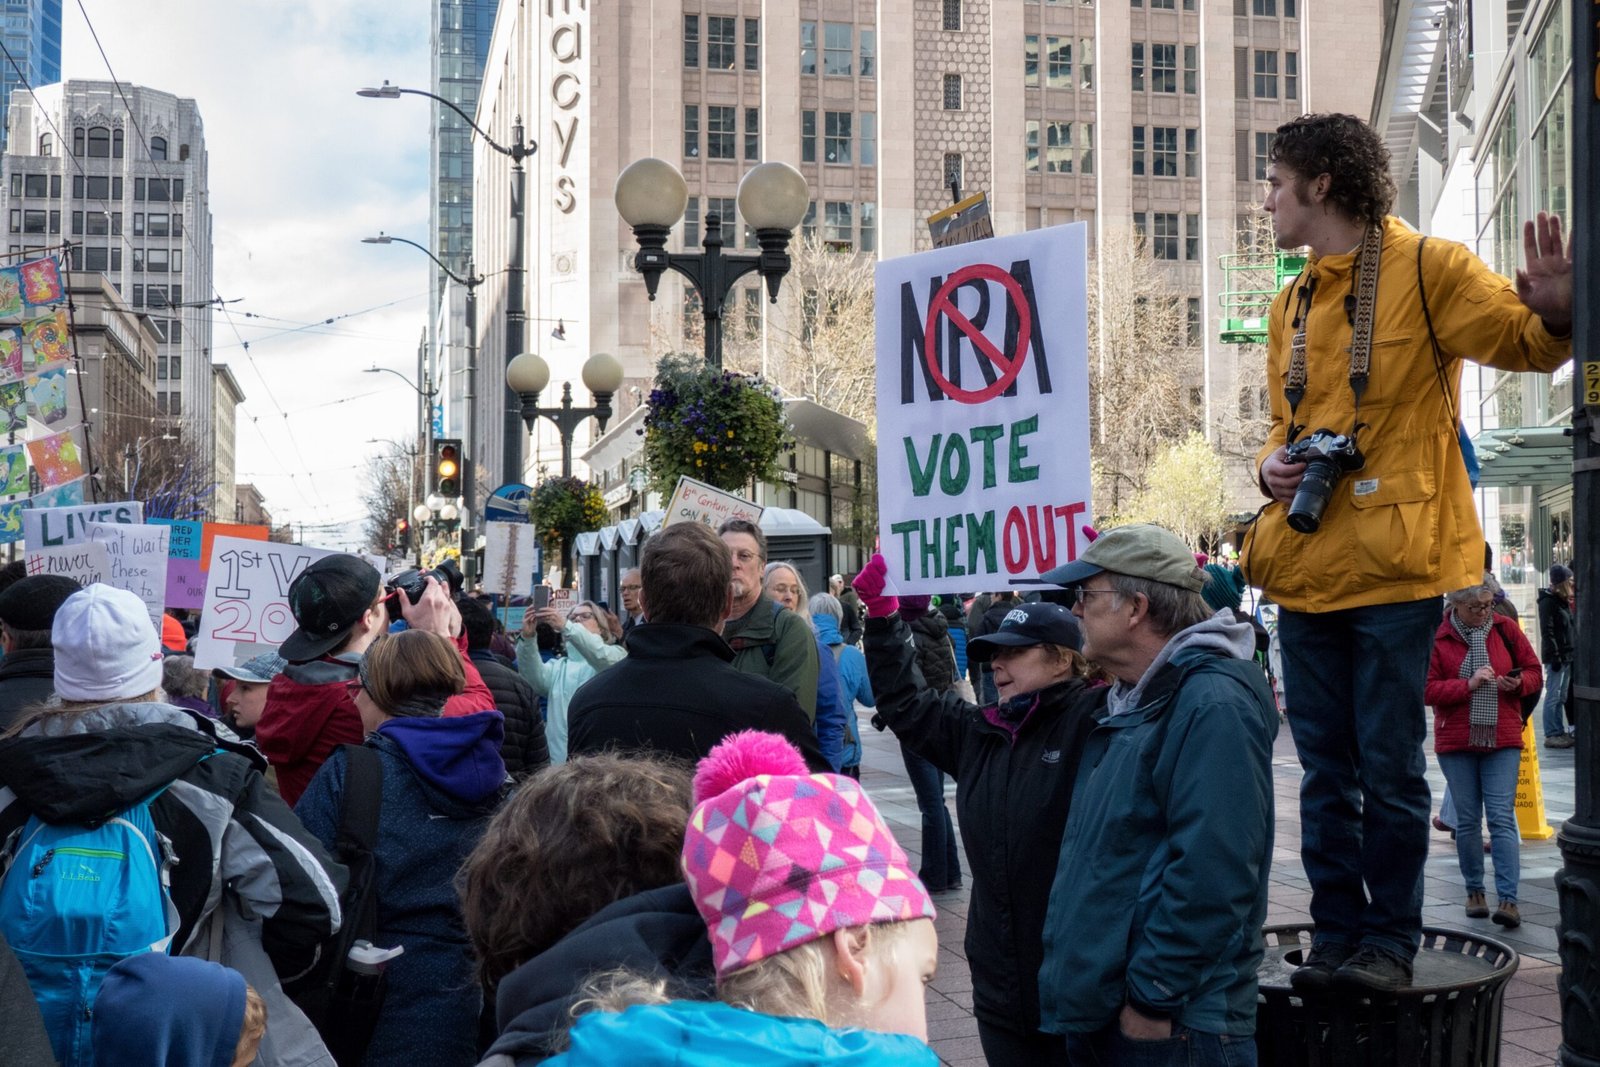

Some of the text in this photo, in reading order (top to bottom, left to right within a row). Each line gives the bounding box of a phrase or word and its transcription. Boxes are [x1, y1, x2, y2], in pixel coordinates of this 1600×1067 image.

[901, 259, 1053, 405] NRA
[1587, 363, 1600, 403] 279
[903, 413, 1040, 497] VOTE
[680, 508, 699, 520] CAN
[698, 493, 730, 519] Century
[170, 524, 193, 535] IRED
[891, 502, 1086, 581] THEM OUT
[27, 551, 94, 575] #never
[111, 558, 149, 579] these
[140, 580, 153, 597] to
[177, 575, 186, 584] IN
[556, 590, 568, 599] NO
